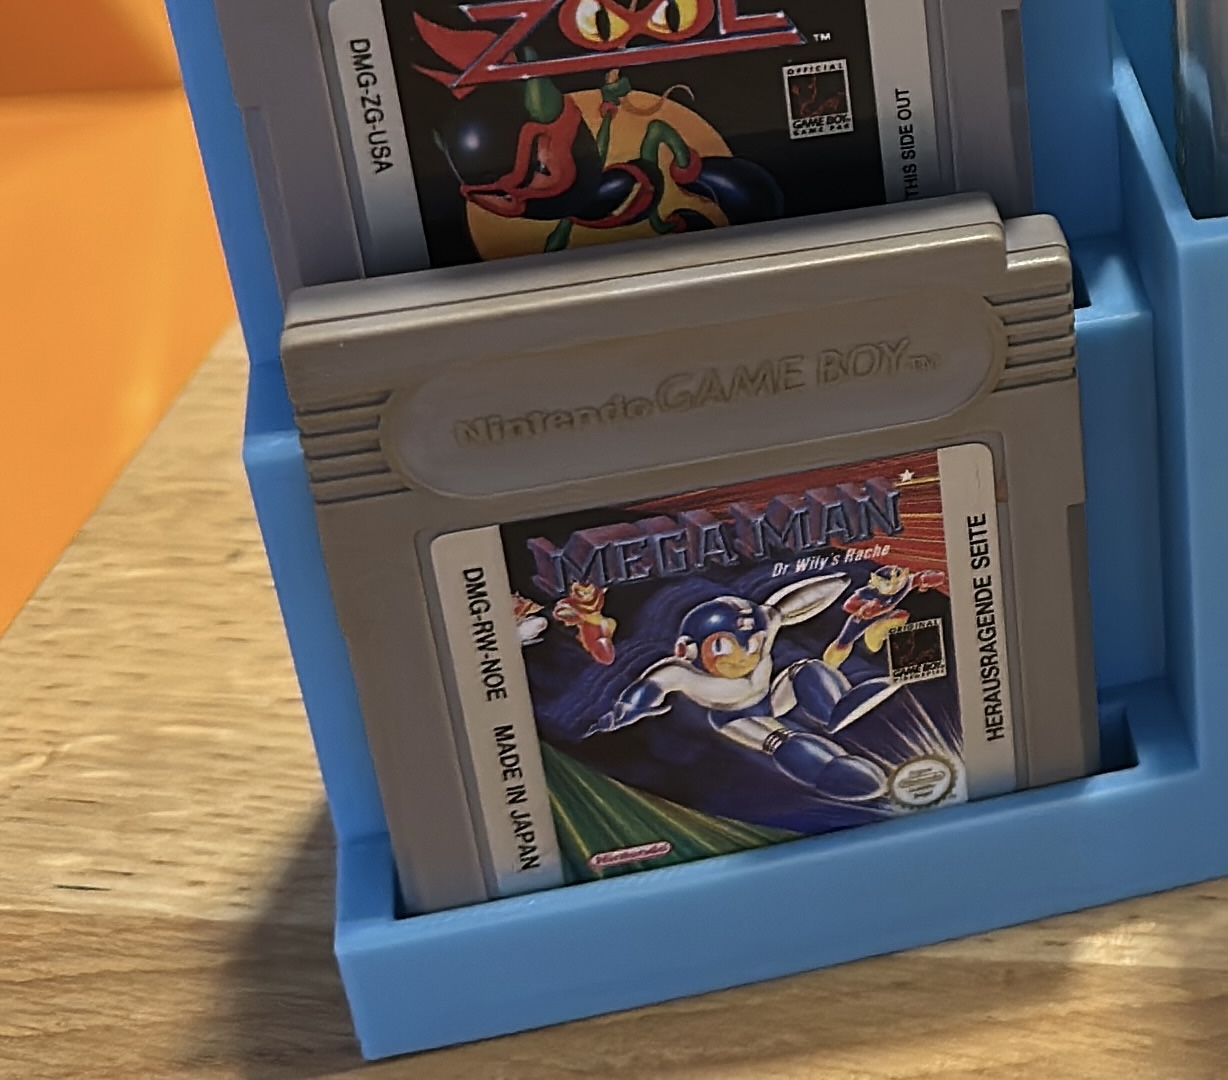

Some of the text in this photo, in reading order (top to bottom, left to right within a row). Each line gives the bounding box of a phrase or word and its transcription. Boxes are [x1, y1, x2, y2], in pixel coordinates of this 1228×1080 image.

[350, 38, 393, 175] DMG-ZG-USA
[895, 88, 919, 200] THIS SIDE OUT
[452, 393, 655, 447] Nintendo
[655, 353, 808, 412] GAME
[815, 336, 911, 387] BOY
[528, 476, 905, 599] MEGA MAN
[771, 543, 891, 578] Dr Wily's Rache
[966, 512, 1004, 743] HERAUSRAGENDE SEITE
[462, 566, 541, 872] DMG-RW-NOE MADE IN JAPAN
